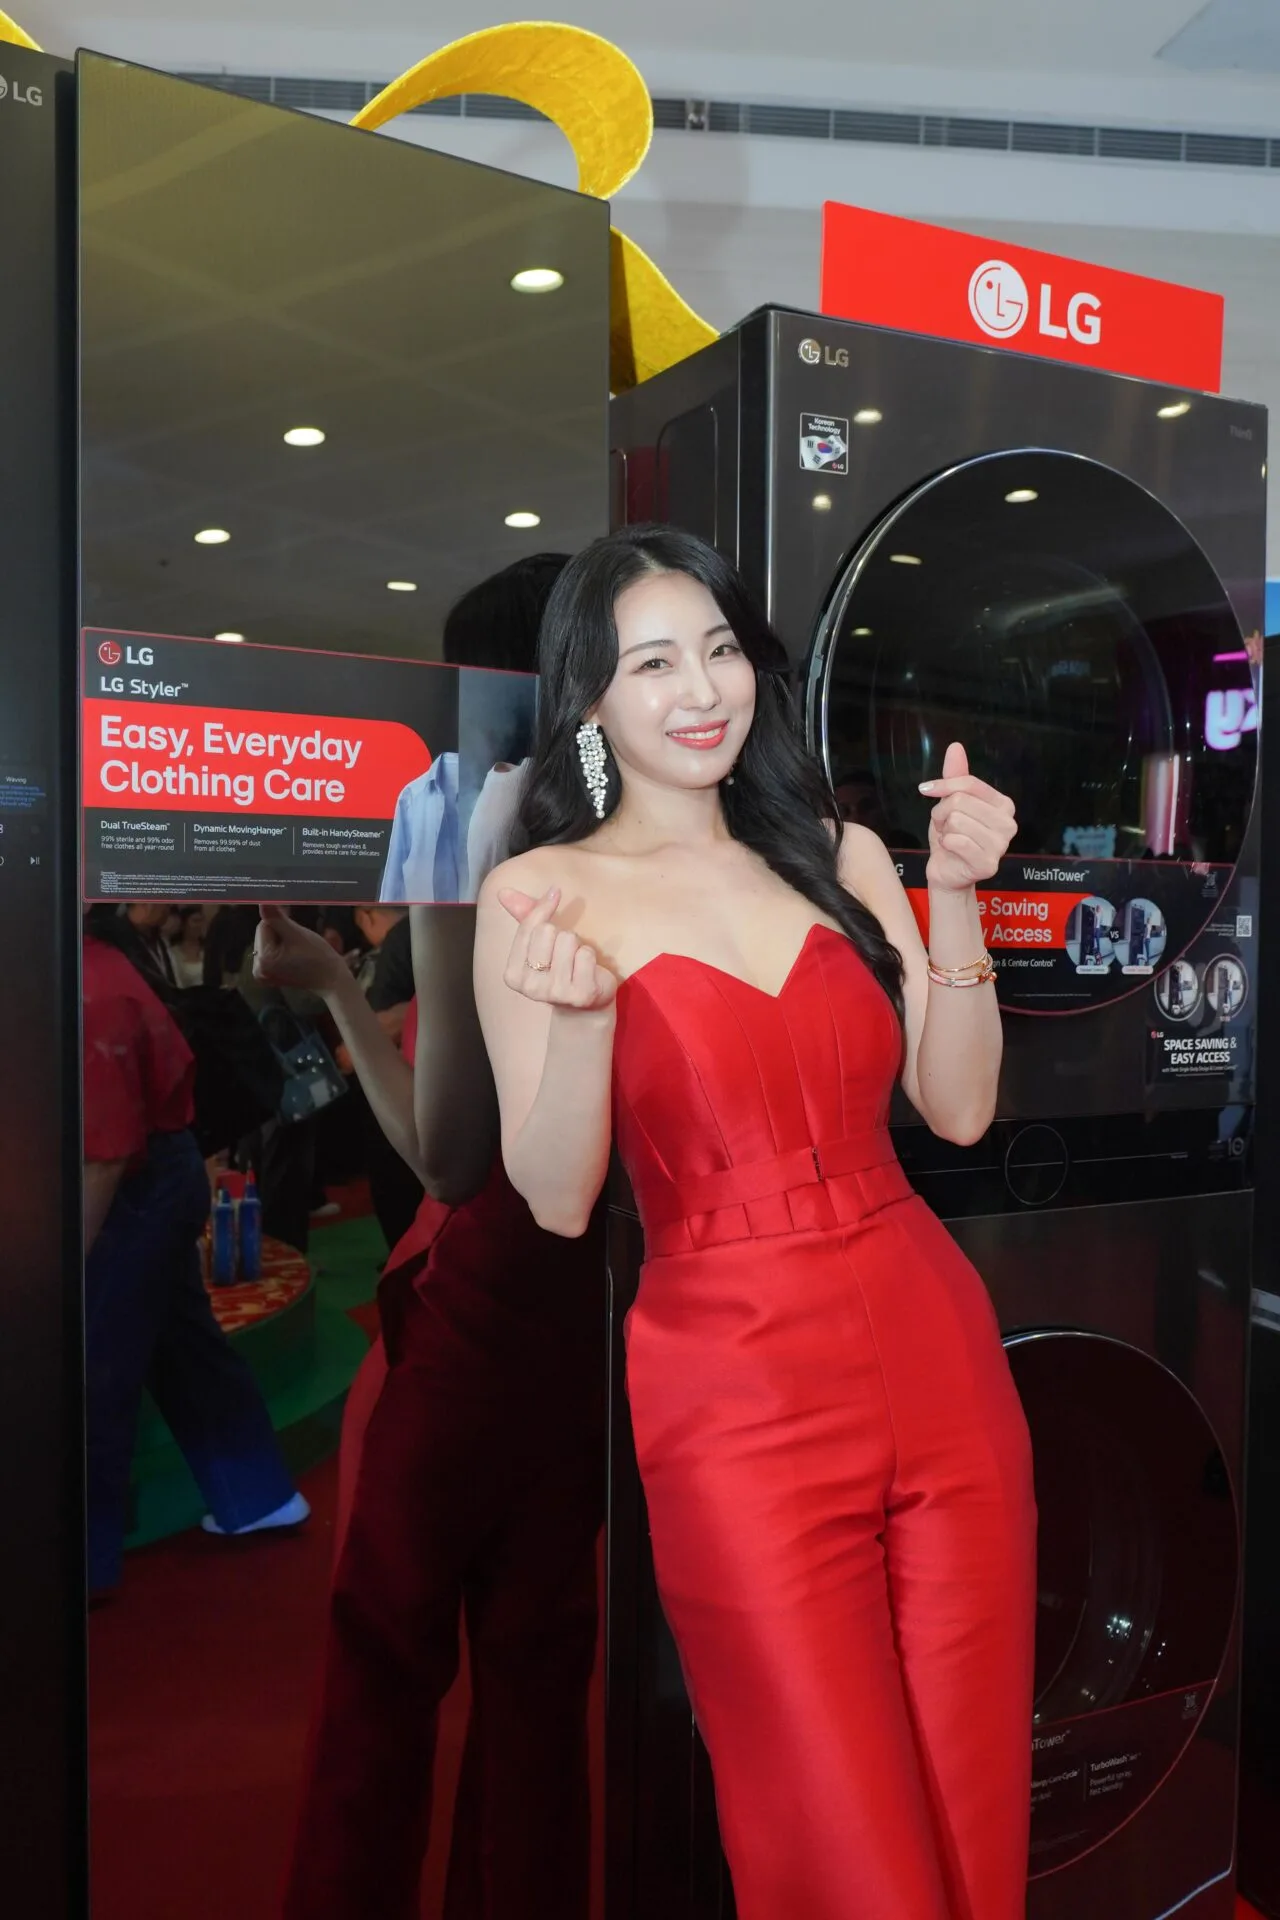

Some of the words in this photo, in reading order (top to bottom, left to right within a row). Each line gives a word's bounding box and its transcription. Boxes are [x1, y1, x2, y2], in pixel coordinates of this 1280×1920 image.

[13, 81, 43, 106] LG
[1039, 283, 1102, 345] LG
[825, 346, 849, 368] LG
[808, 423, 841, 435] Technology
[814, 418, 835, 427] Korean
[126, 646, 154, 666] LG
[100, 676, 124, 693] LG
[100, 714, 194, 759] Easy,
[203, 722, 362, 769] Everyday
[100, 759, 254, 806] Clothing
[263, 769, 346, 803] Care
[100, 820, 120, 830] Dual
[193, 823, 227, 834] Dynamic
[302, 828, 329, 837] Built-in
[144, 844, 175, 852] year-round
[326, 842, 341, 850] tough
[895, 863, 904, 877] G
[990, 897, 1049, 922] Saving
[991, 923, 1053, 943] Access
[1110, 931, 1120, 940] VS
[1001, 959, 1007, 968] &
[1007, 959, 1029, 968] Center
[1164, 1039, 1194, 1051] SPACE
[1194, 1038, 1229, 1050] SAVING
[1230, 1037, 1237, 1049] &
[1171, 1052, 1195, 1065] EASY
[1196, 1051, 1231, 1064] ACCESS
